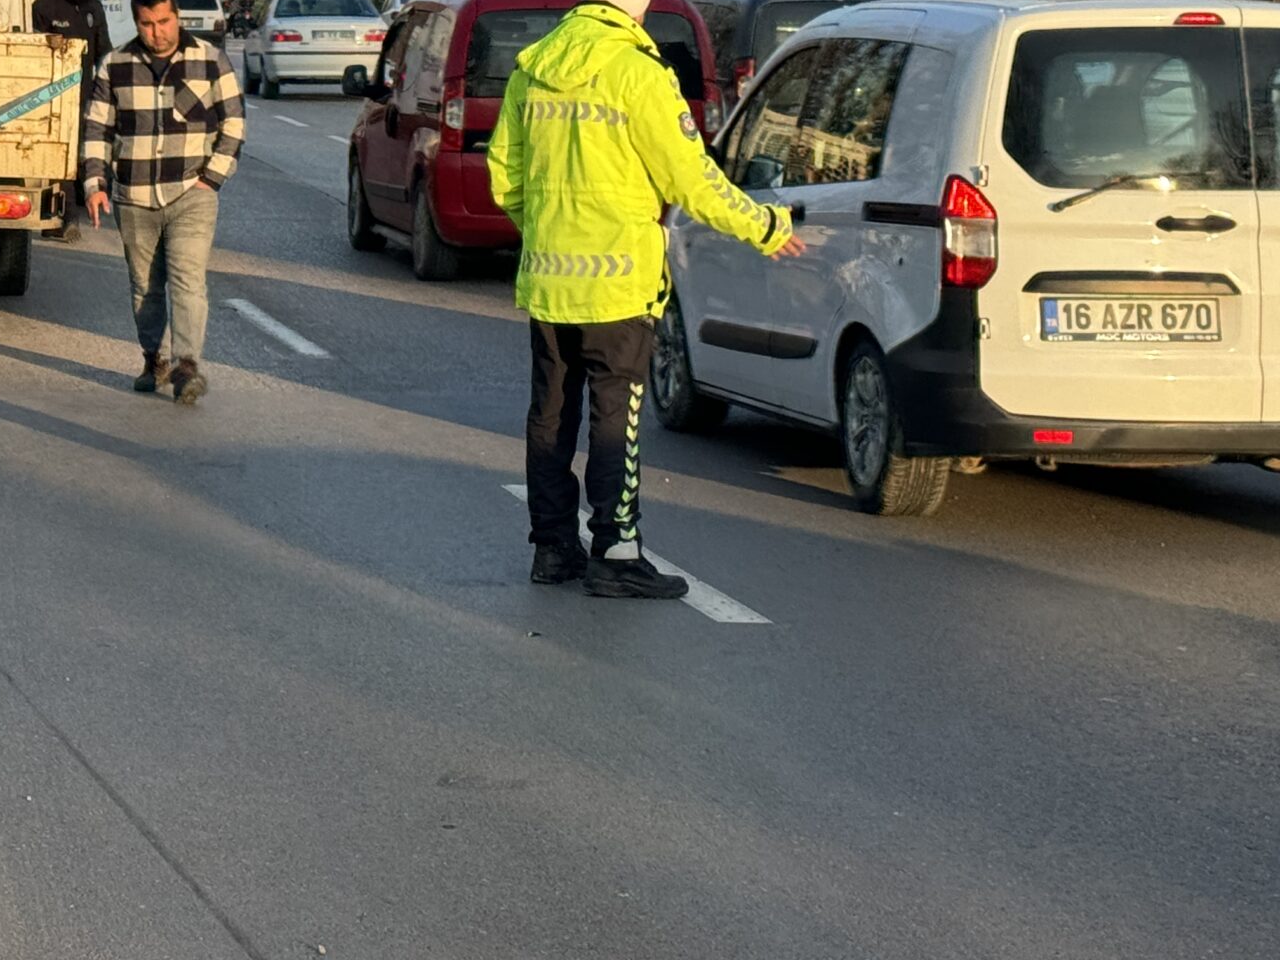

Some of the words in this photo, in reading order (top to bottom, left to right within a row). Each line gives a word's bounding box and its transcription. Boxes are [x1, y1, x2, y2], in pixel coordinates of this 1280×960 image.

[1062, 303, 1091, 330] 16
[1101, 303, 1153, 330] AZR
[1161, 303, 1212, 331] 670
